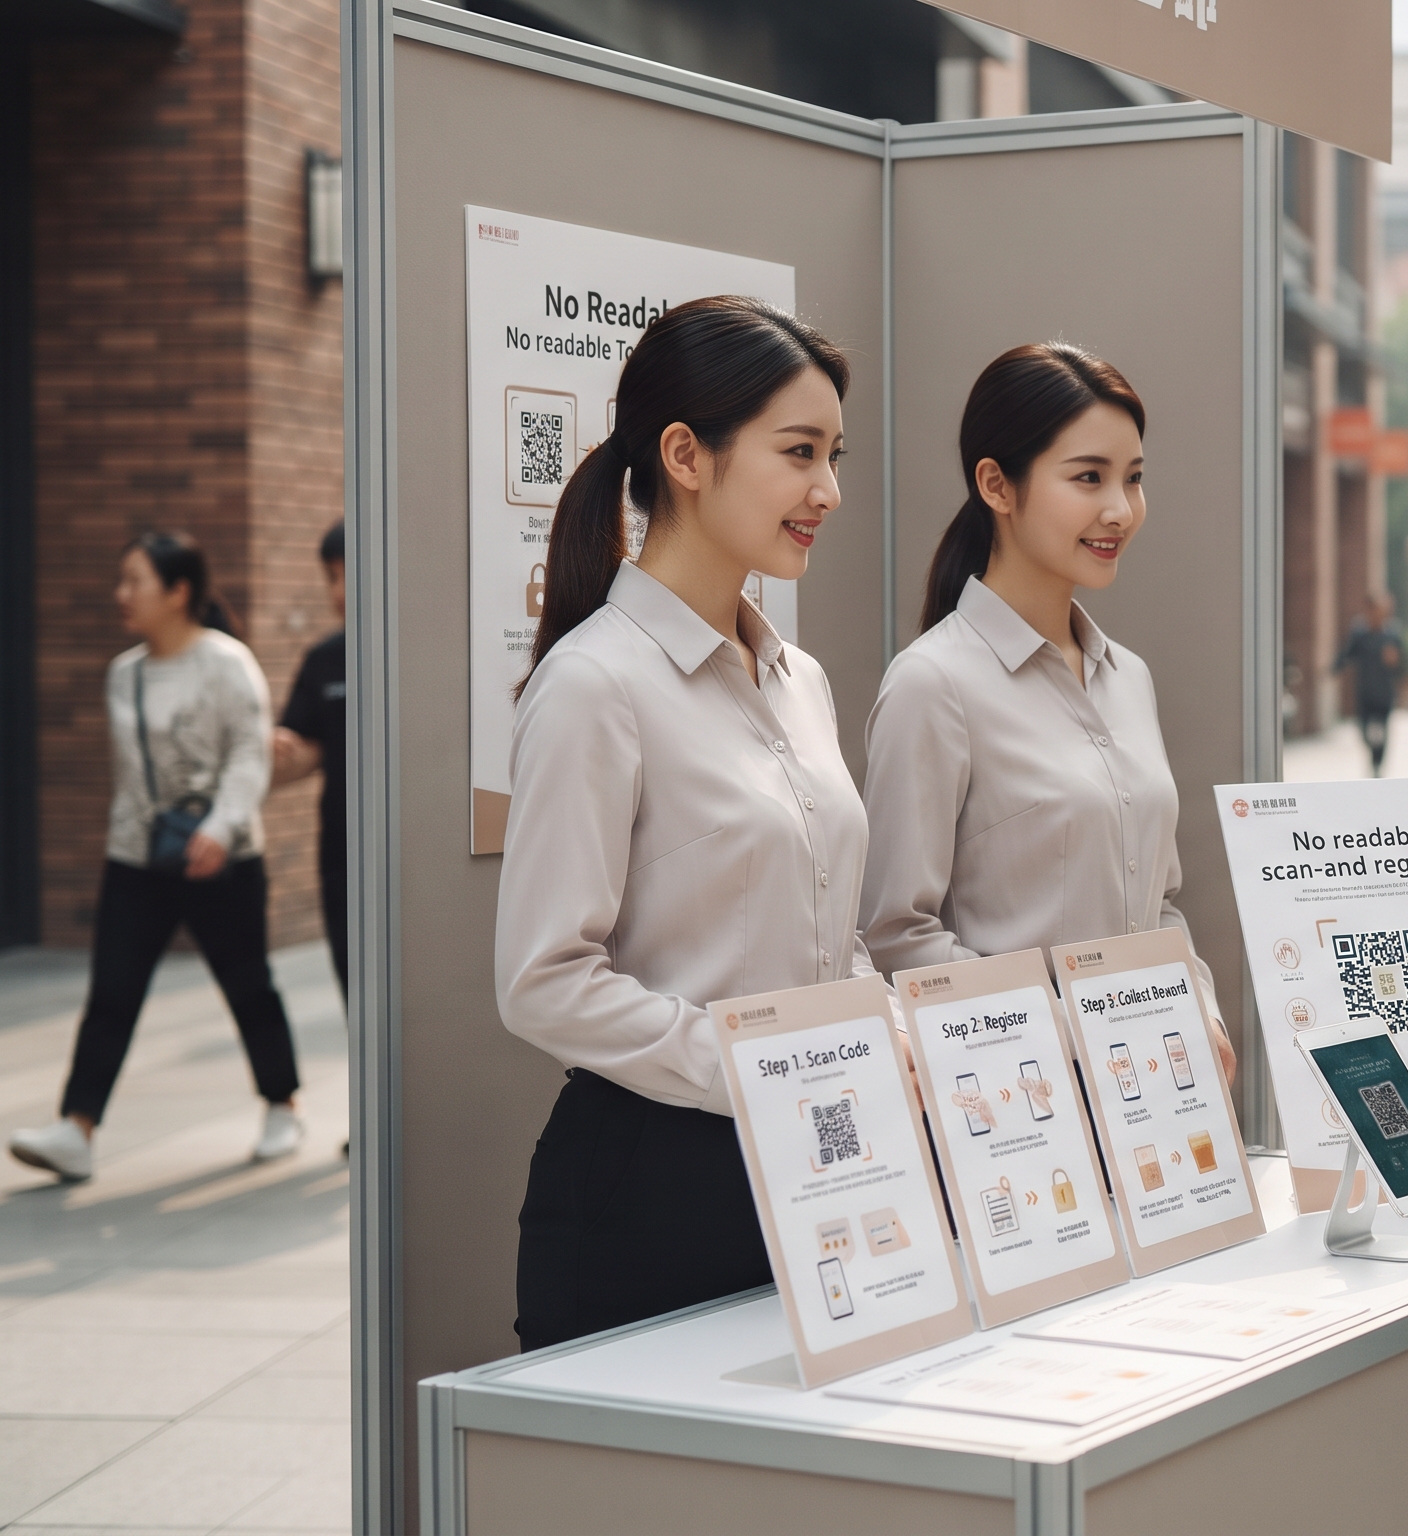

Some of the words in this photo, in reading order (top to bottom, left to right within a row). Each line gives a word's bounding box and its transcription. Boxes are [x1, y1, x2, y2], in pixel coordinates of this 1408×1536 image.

[545, 284, 579, 320] No
[506, 325, 531, 351] No
[536, 332, 612, 360] readable
[1292, 830, 1326, 851] No
[1261, 855, 1368, 882] scan-and
[1080, 998, 1106, 1015] Step
[941, 1022, 969, 1041] Step
[983, 1011, 1028, 1033] Register
[758, 1058, 789, 1078] Step
[805, 1050, 837, 1068] Scan
[838, 1040, 871, 1061] Code
